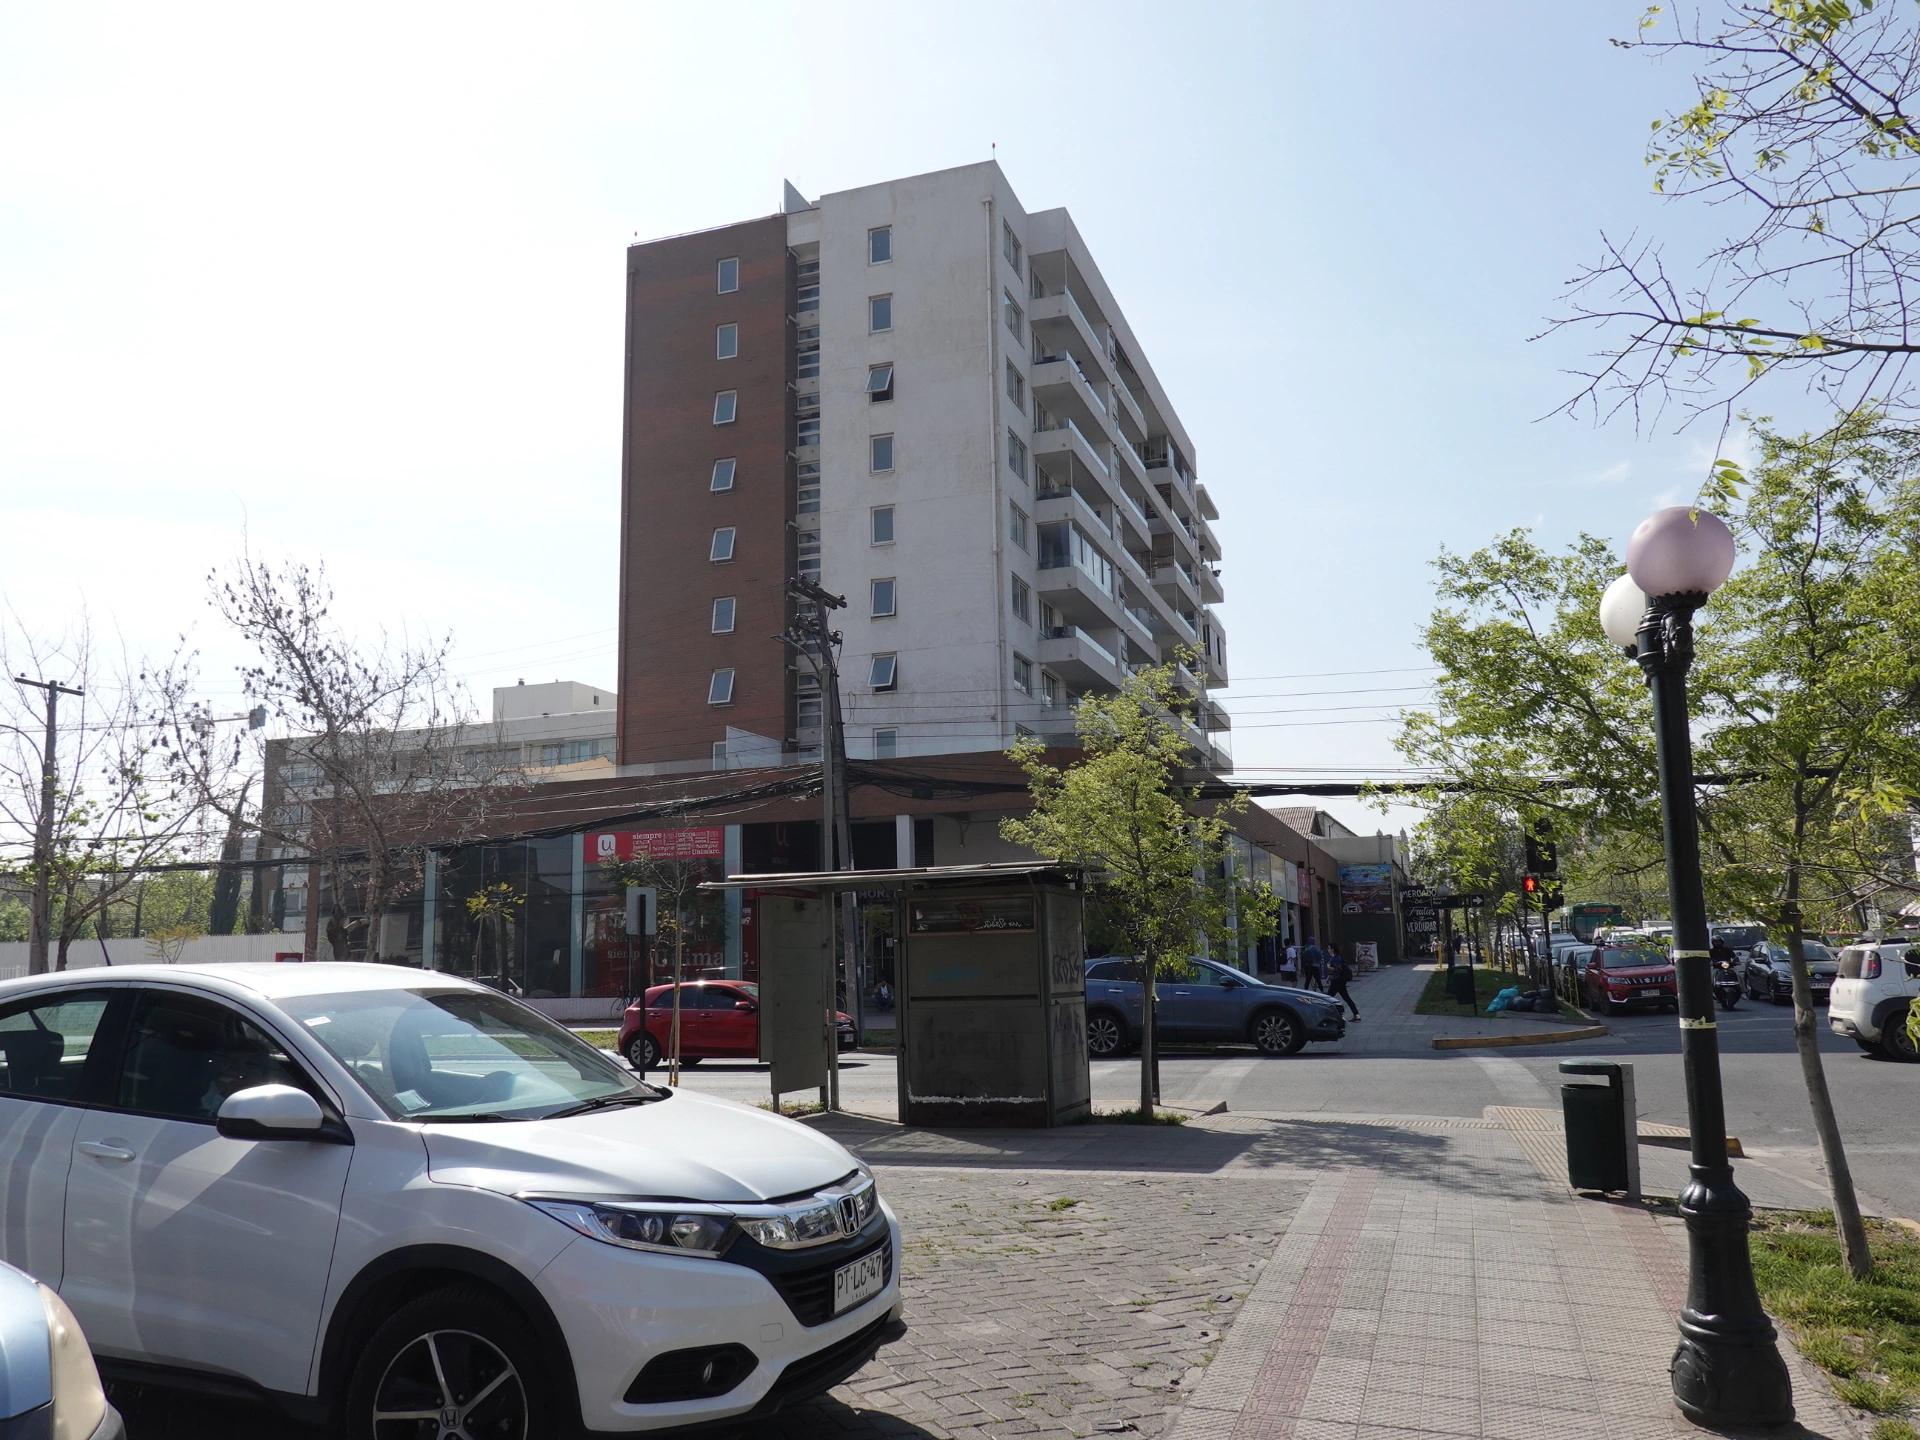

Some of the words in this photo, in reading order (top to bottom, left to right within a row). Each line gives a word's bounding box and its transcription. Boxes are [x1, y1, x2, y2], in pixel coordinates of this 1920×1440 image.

[632, 832, 662, 841] siempre
[1402, 888, 1437, 898] MERCADO
[1406, 921, 1437, 933] VERDURAS
